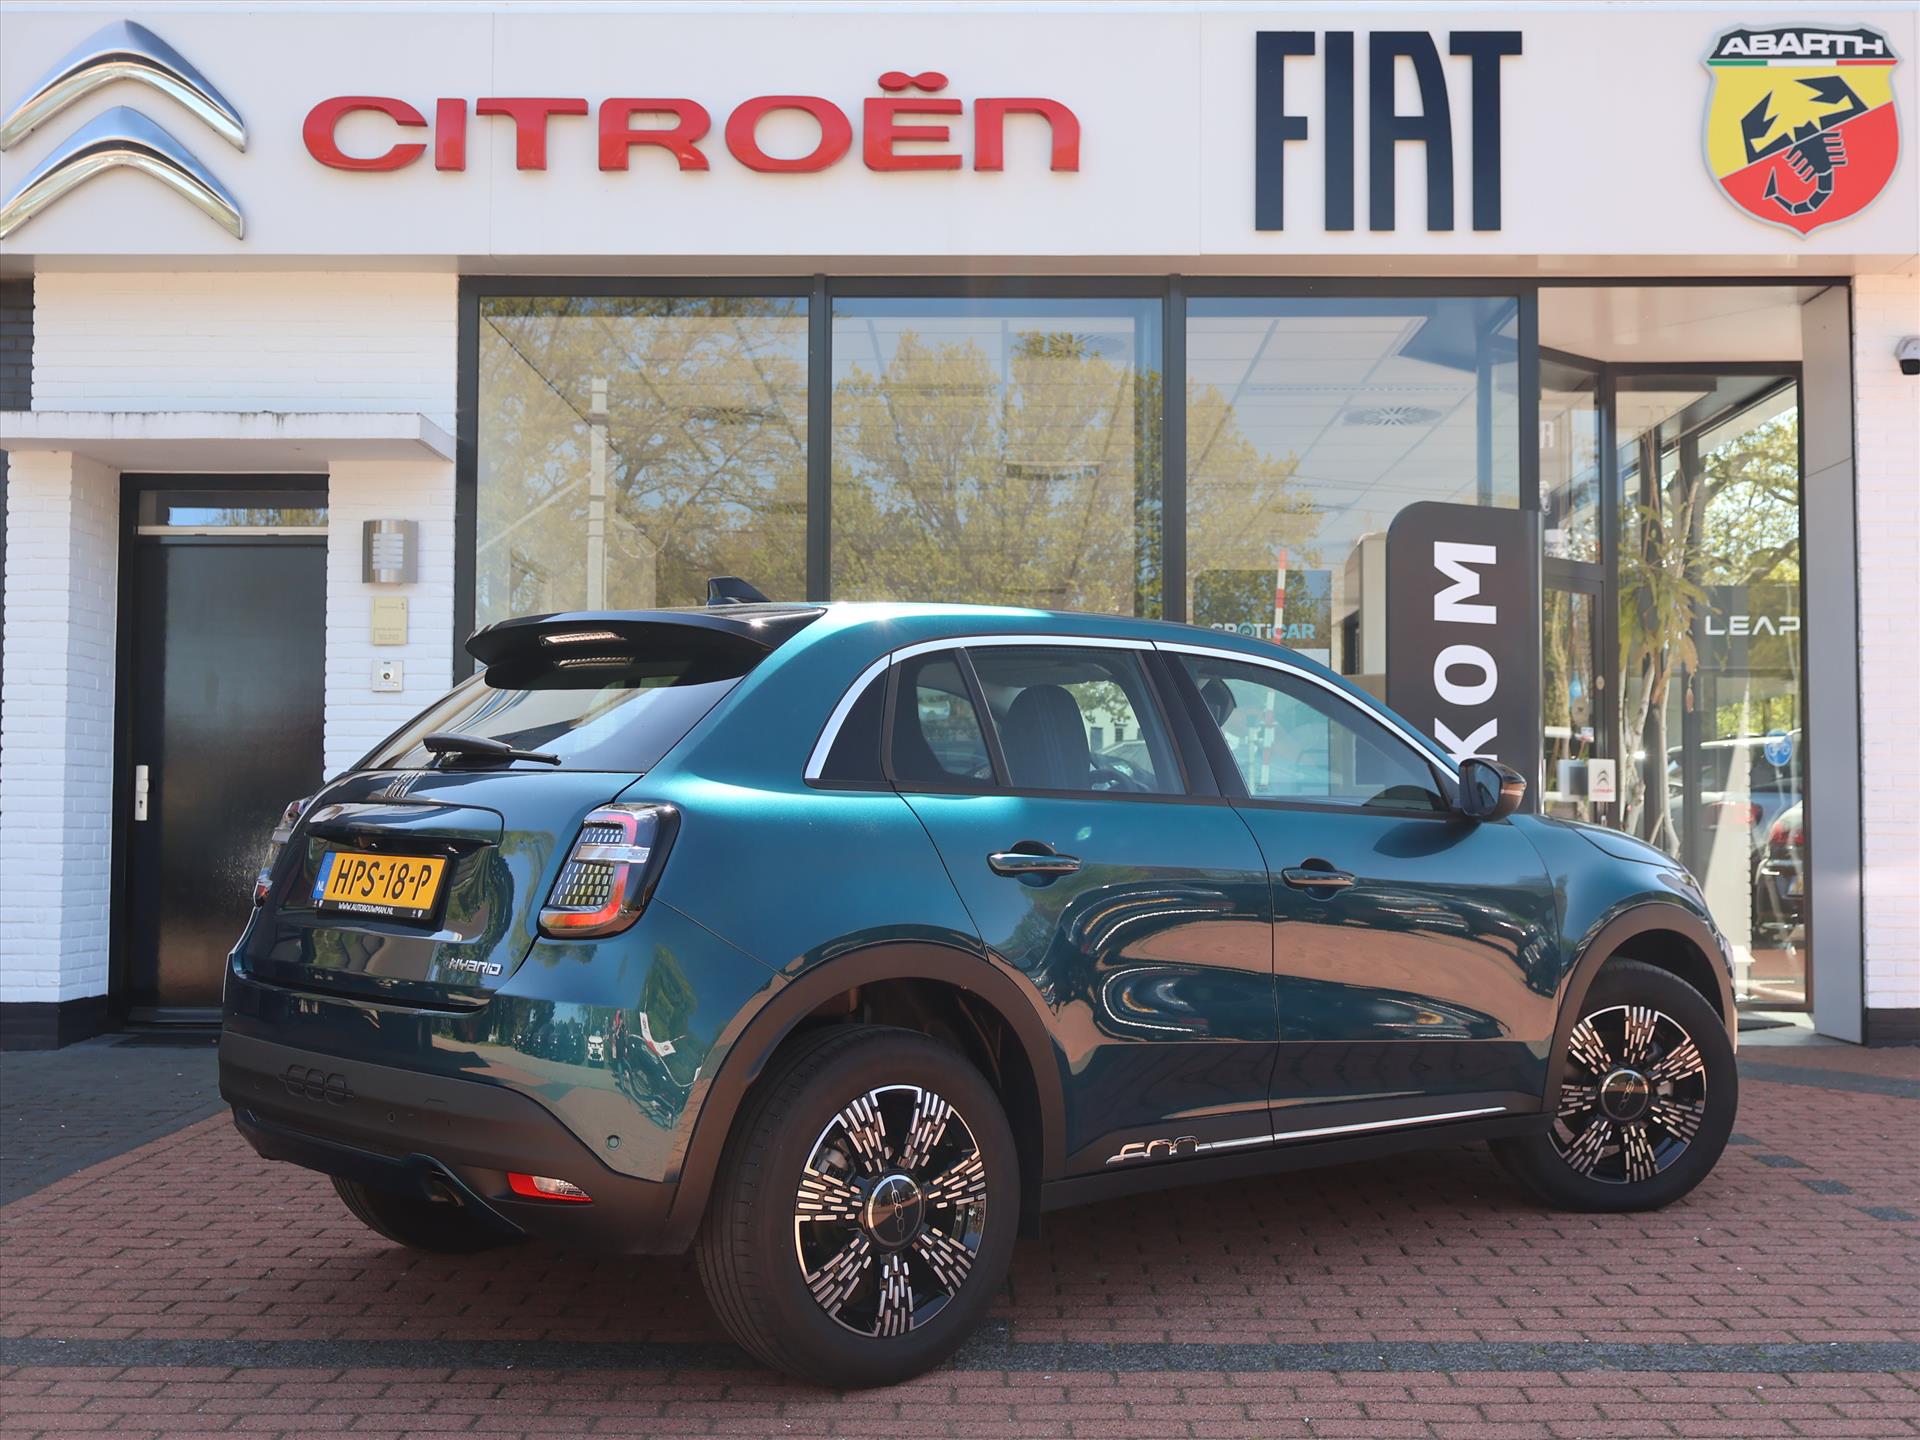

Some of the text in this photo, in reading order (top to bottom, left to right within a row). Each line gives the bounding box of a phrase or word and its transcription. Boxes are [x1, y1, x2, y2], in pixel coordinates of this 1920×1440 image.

[1720, 32, 1883, 55] ABARTH
[303, 70, 1082, 173] CITROËN
[1256, 31, 1522, 231] FIAT
[1705, 616, 1800, 635] LEAP
[316, 881, 324, 892] NL
[333, 859, 432, 901] HPS-18-P
